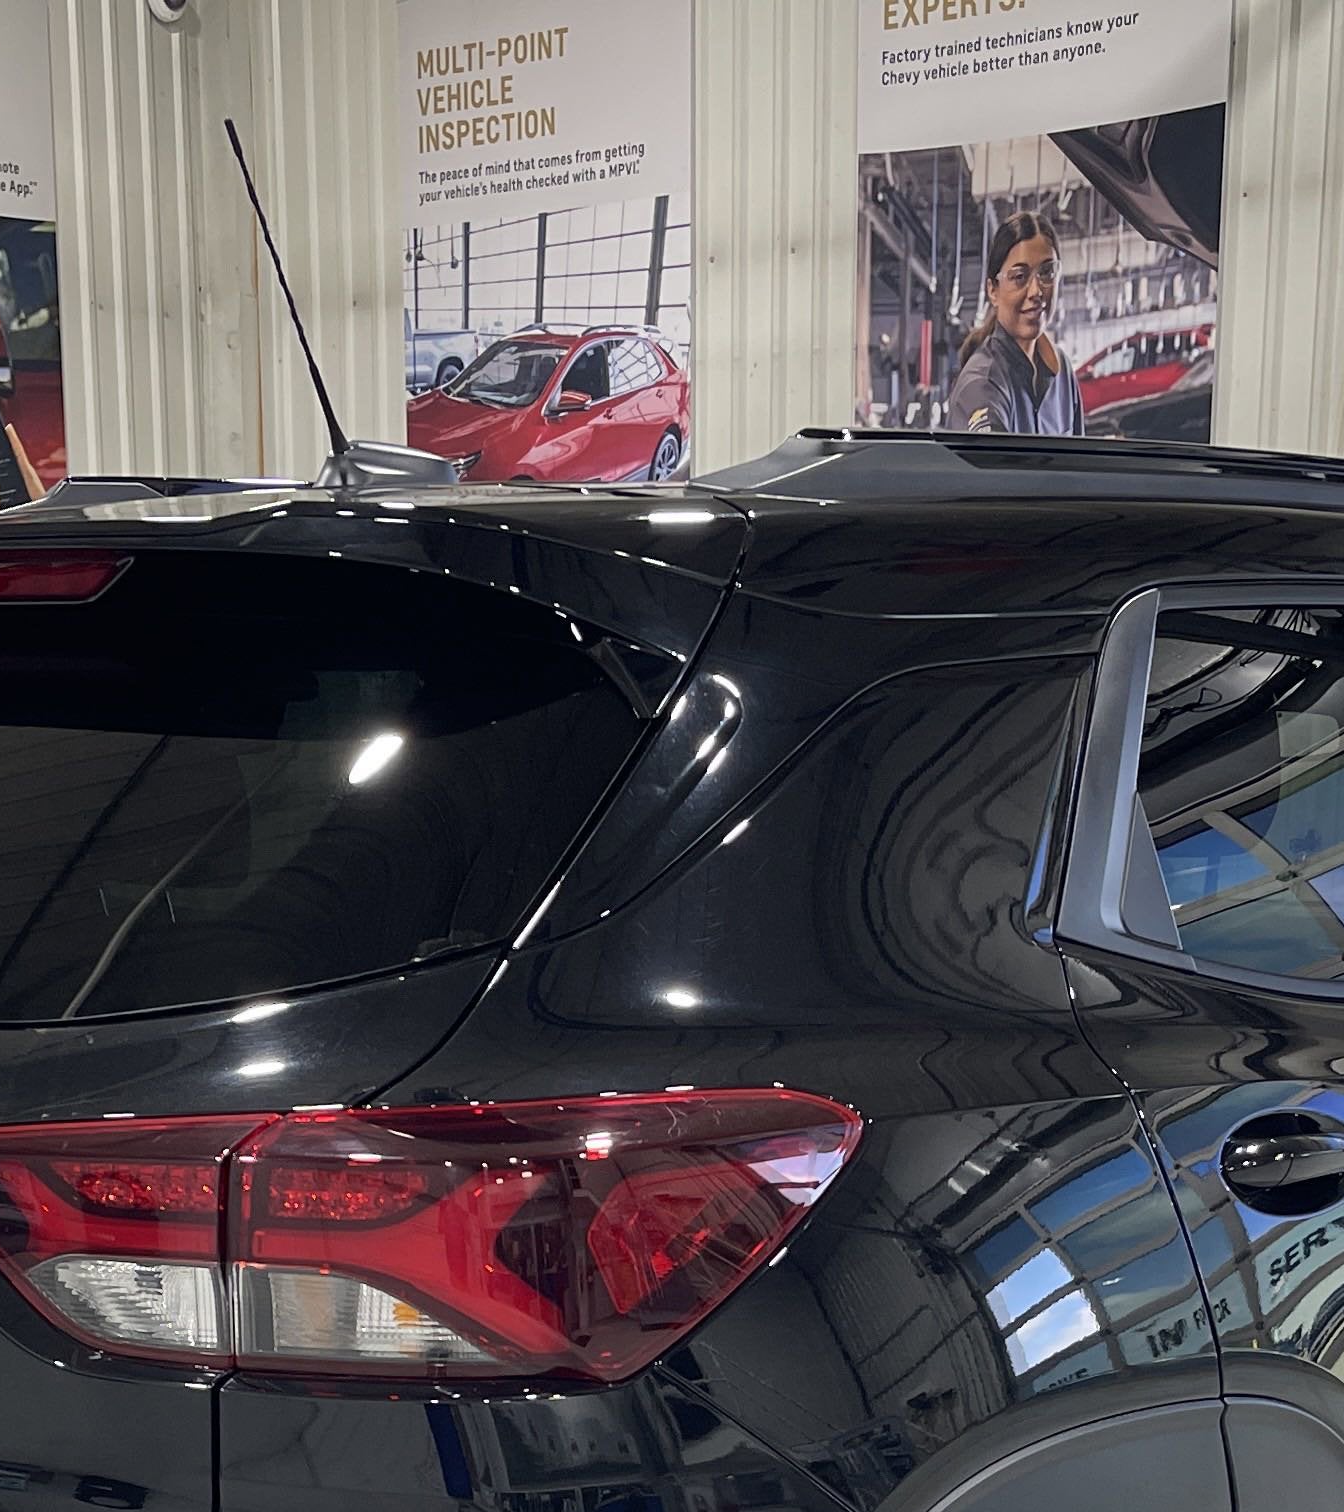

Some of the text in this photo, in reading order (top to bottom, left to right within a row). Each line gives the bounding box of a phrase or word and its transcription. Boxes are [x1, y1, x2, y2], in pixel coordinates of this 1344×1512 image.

[417, 27, 569, 79] MULTI-POINT
[882, 12, 1139, 65] Factory trained technicians know your
[882, 42, 1106, 86] Chevy vehicle better than anyone.
[416, 75, 514, 116] VEHICLE
[418, 107, 556, 154] INSPECTION
[419, 142, 645, 185] The peace of mind that comes from getting
[419, 190, 442, 206] your
[444, 182, 488, 200] vehicle's
[490, 178, 523, 194] health
[526, 170, 569, 189] checked
[572, 167, 596, 182] with
[599, 169, 605, 179] a
